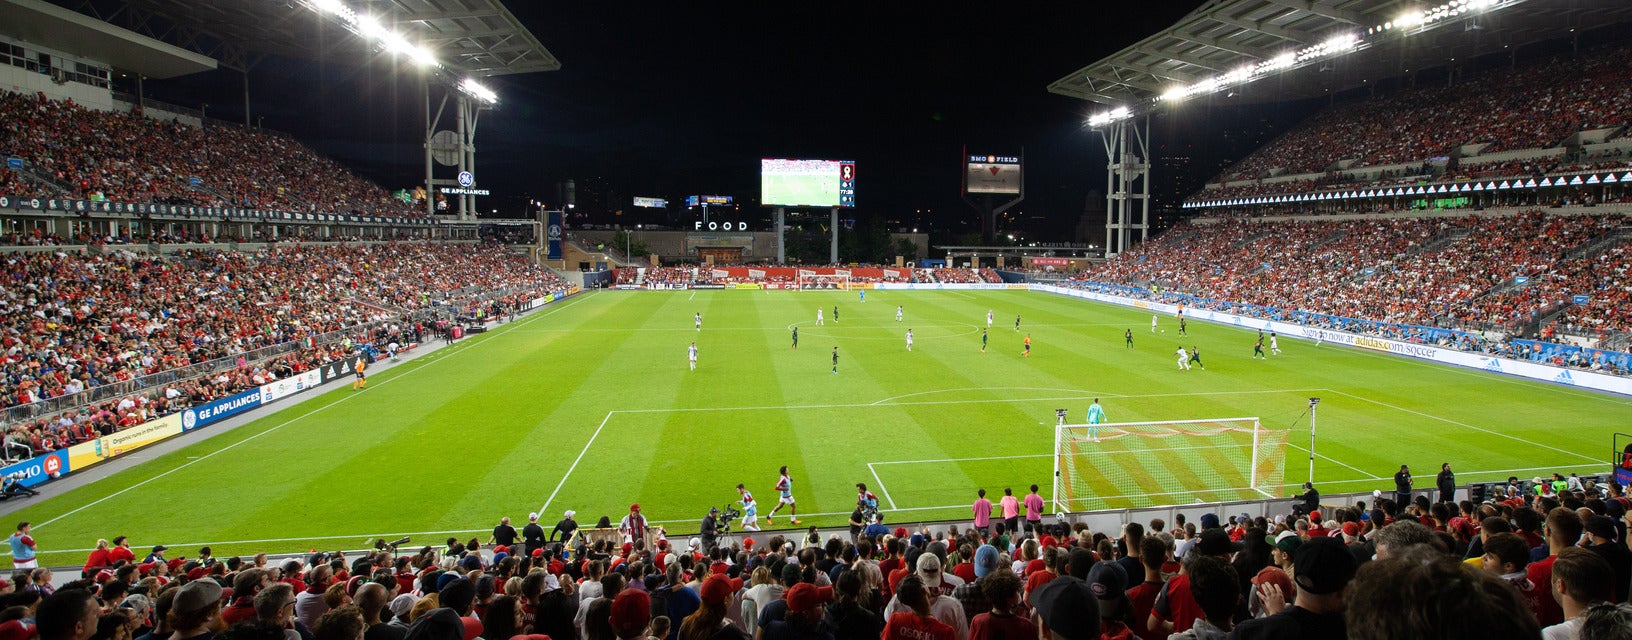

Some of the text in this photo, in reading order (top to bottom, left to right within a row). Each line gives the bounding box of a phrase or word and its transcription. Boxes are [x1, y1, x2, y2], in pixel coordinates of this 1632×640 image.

[451, 188, 490, 196] APPLIANCES
[695, 221, 747, 231] FOOD
[1328, 331, 1344, 341] now
[1346, 333, 1354, 343] at
[199, 408, 211, 420] GE
[213, 392, 260, 416] APPLIANCES
[113, 435, 131, 444] Organic
